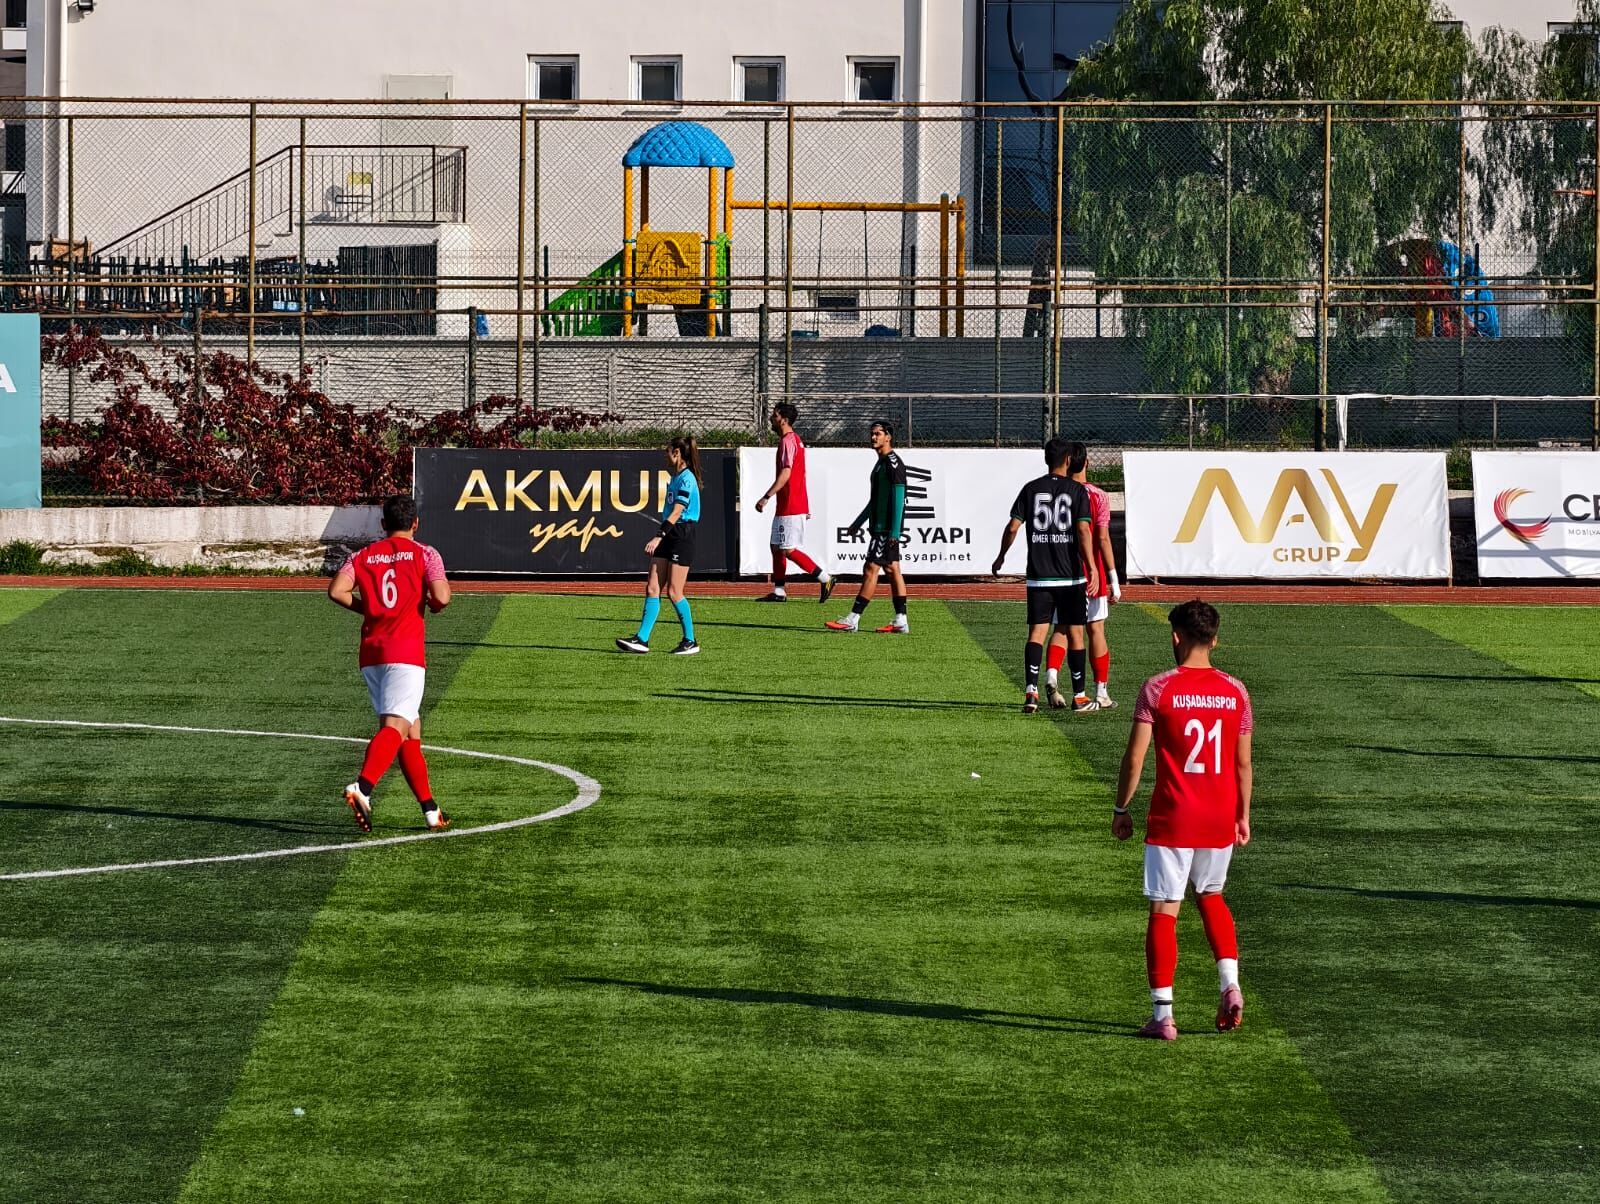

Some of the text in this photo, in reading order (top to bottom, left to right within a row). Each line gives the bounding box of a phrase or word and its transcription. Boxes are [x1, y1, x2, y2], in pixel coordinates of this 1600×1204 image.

[1033, 492, 1073, 532] 56
[836, 527, 971, 548] ERŞ YAPI
[1032, 531, 1049, 543] ÖMER
[1272, 546, 1340, 563] GRUP
[381, 568, 398, 609] 6
[1172, 694, 1237, 711] KUŞADASISPOR
[1183, 718, 1223, 775] 21
